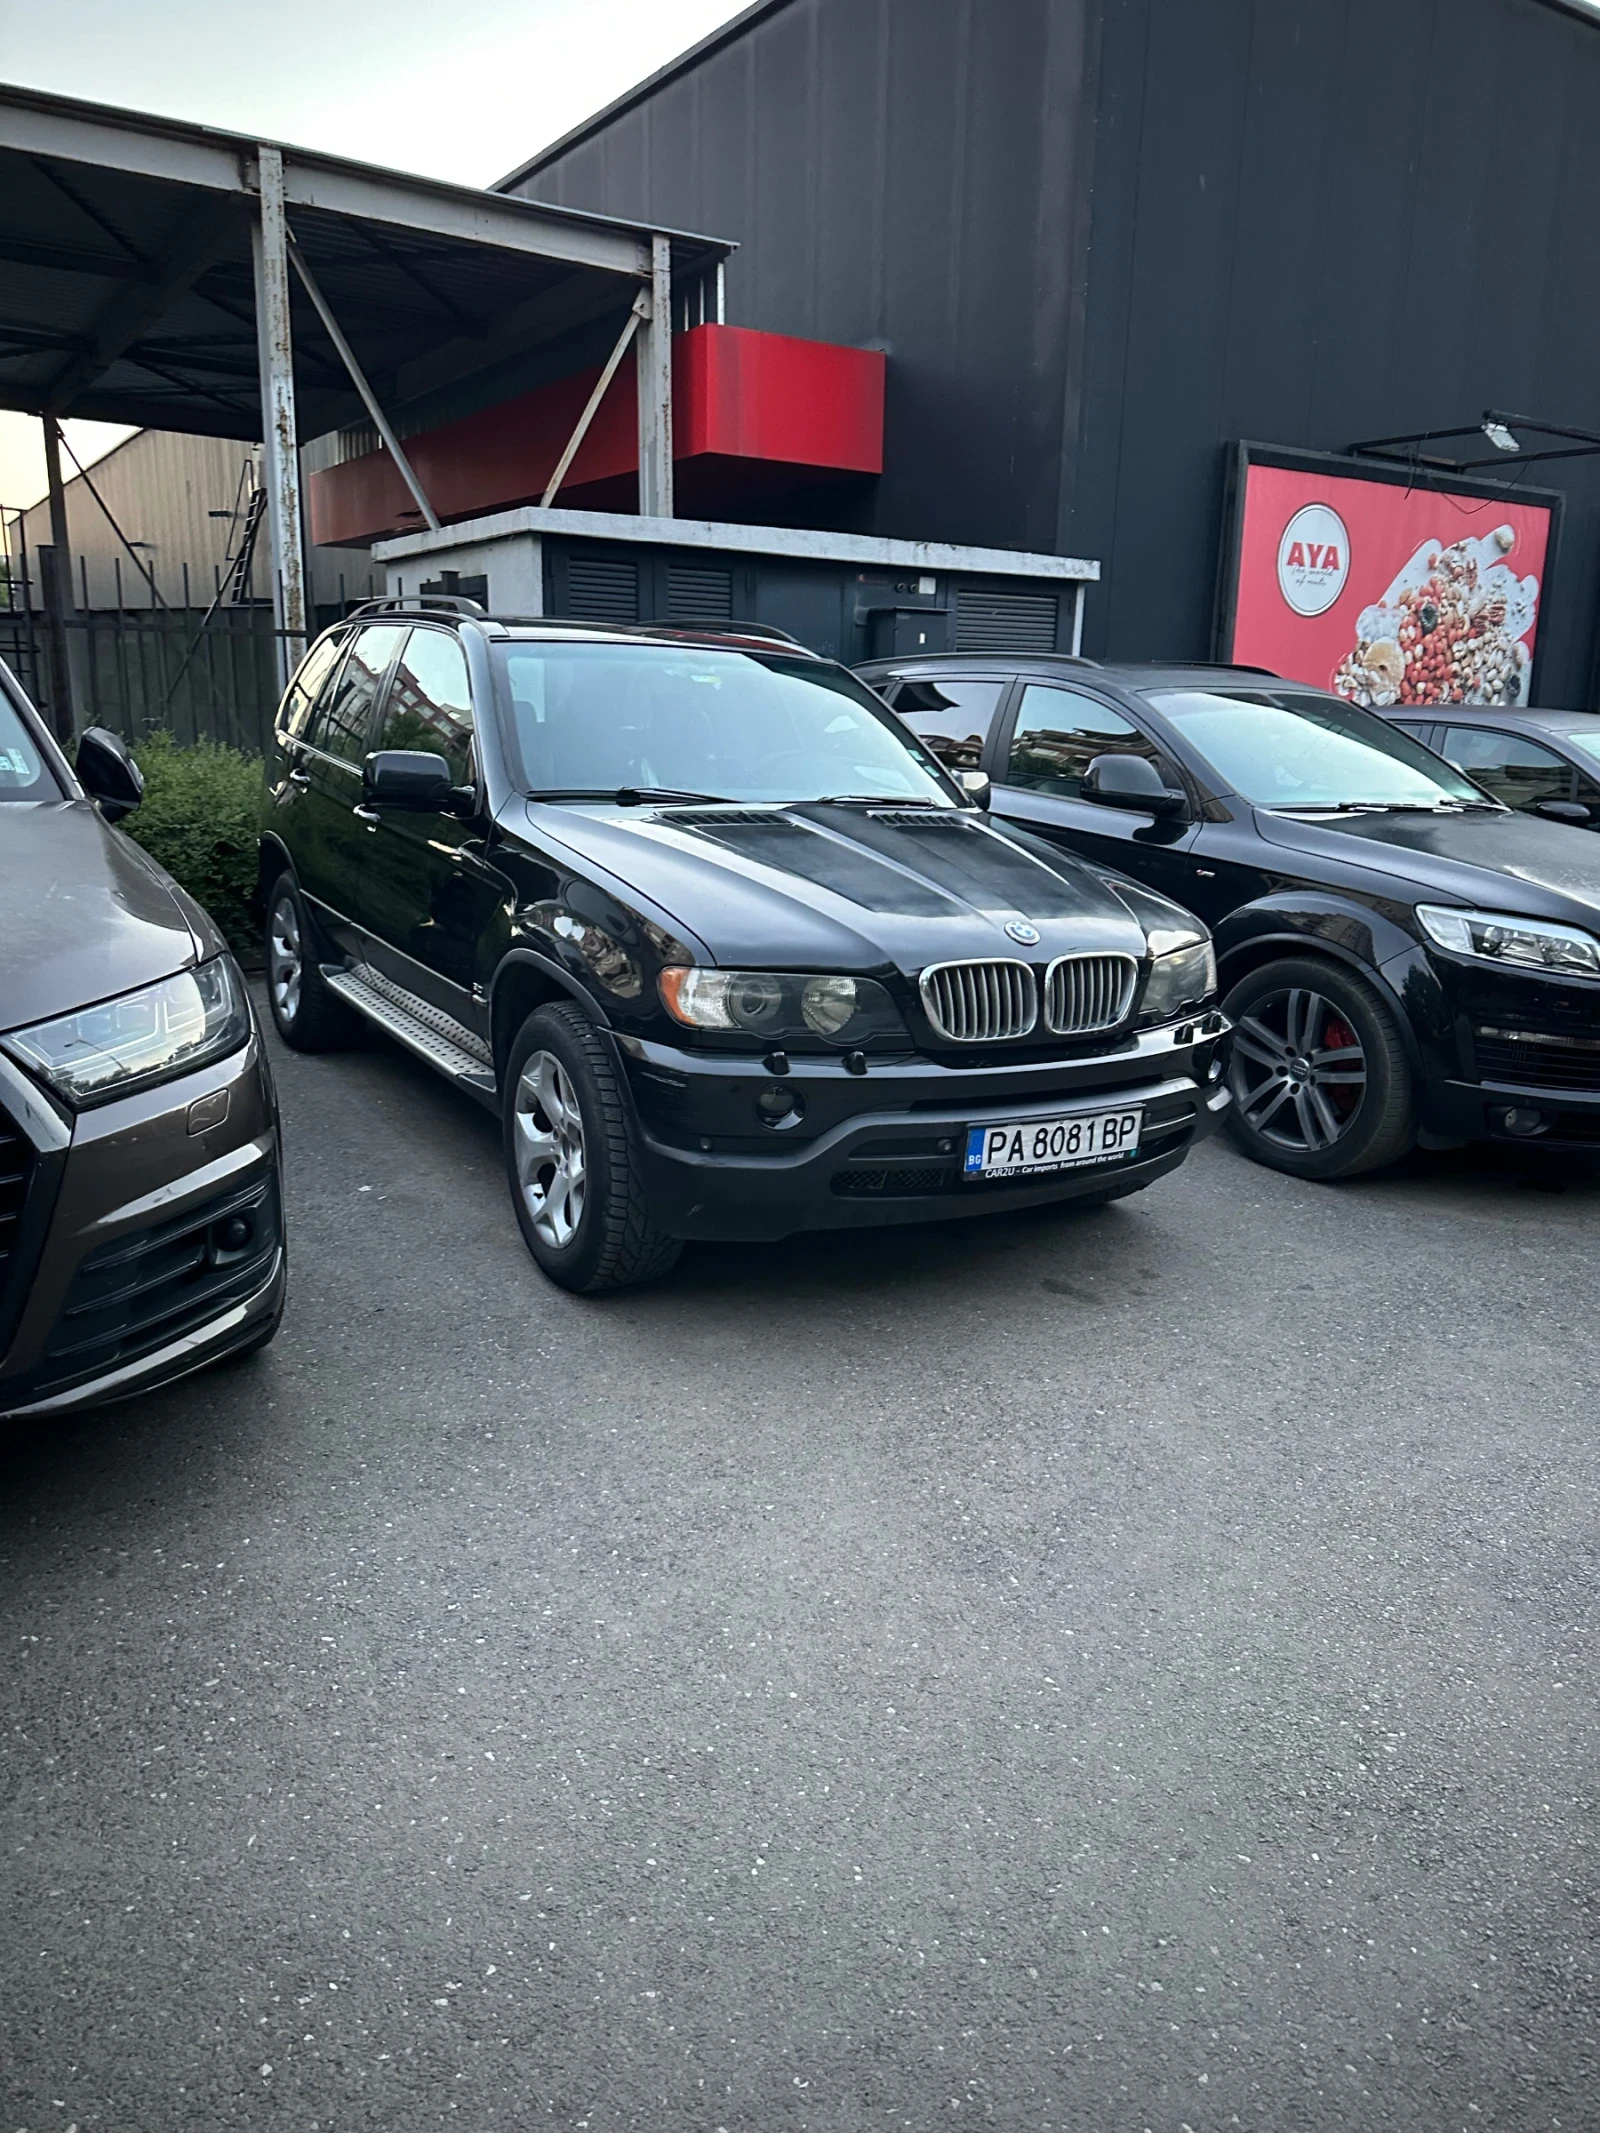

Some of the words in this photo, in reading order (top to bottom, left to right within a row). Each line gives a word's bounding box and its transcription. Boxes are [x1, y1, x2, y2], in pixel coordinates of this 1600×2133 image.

[1287, 541, 1340, 570] AYA
[987, 1130, 1024, 1164] PA
[1033, 1121, 1096, 1159] 8081
[1102, 1115, 1136, 1150] BP
[968, 1155, 982, 1166] BG
[985, 1167, 1015, 1178] CAR2U
[1033, 1163, 1059, 1172] imports
[1060, 1160, 1076, 1169] from
[1075, 1156, 1097, 1166] around
[1096, 1155, 1107, 1163] the
[1107, 1152, 1124, 1161] world
